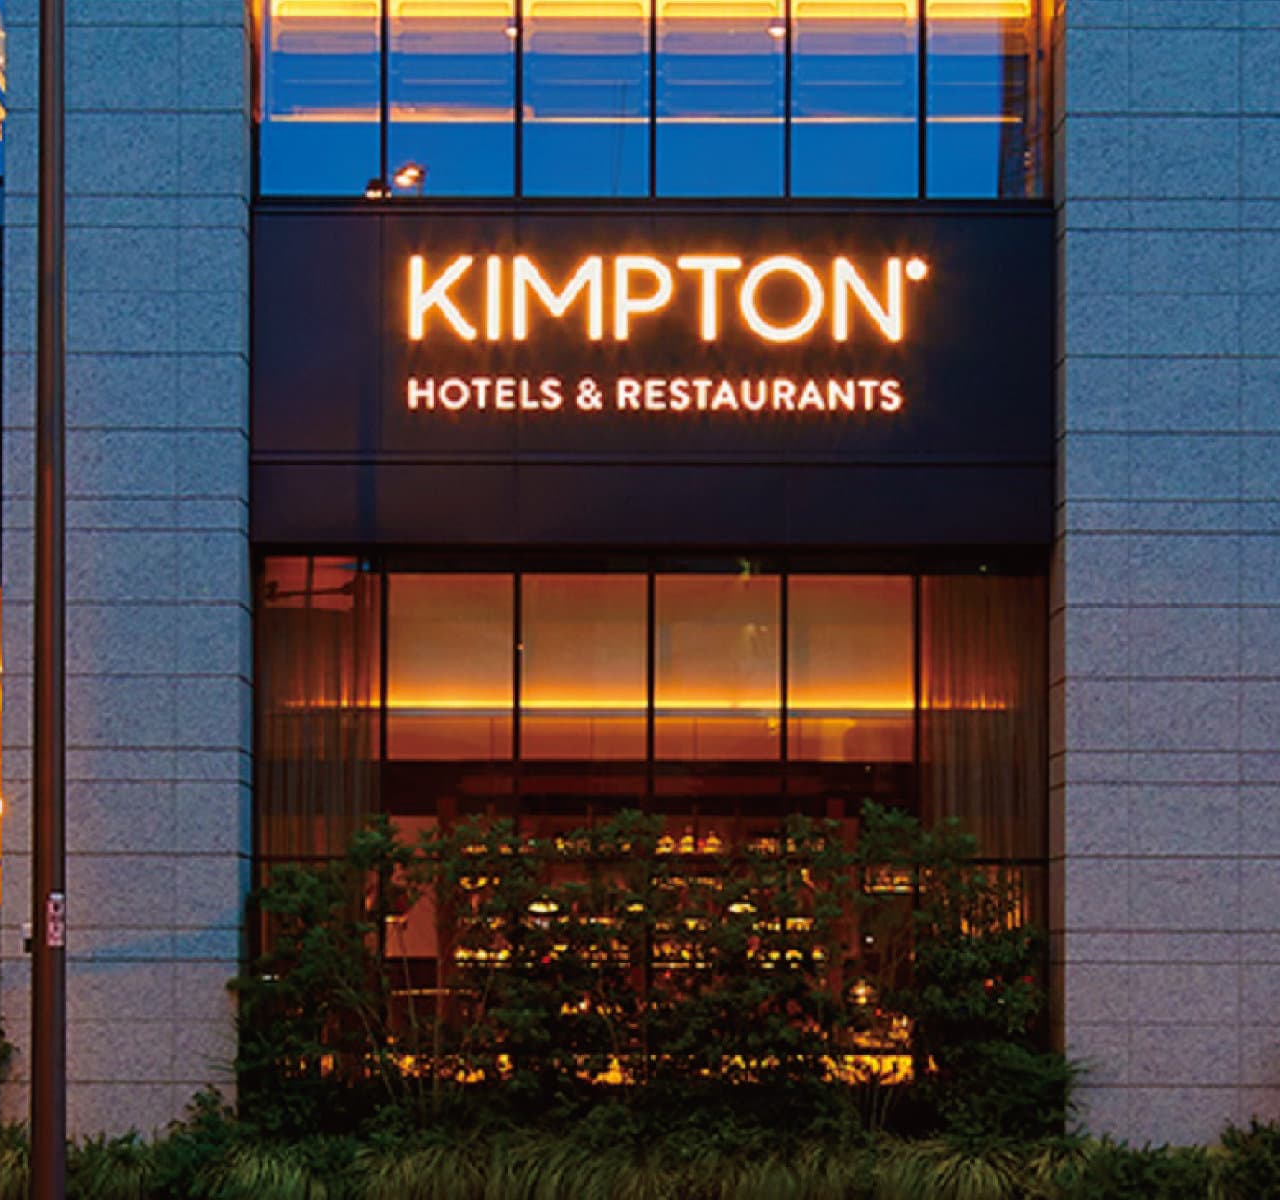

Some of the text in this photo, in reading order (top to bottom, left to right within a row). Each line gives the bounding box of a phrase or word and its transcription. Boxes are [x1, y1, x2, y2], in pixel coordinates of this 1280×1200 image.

[407, 254, 903, 343] KIMPTON
[407, 377, 902, 411] HOTELS & RESTAURANTS
